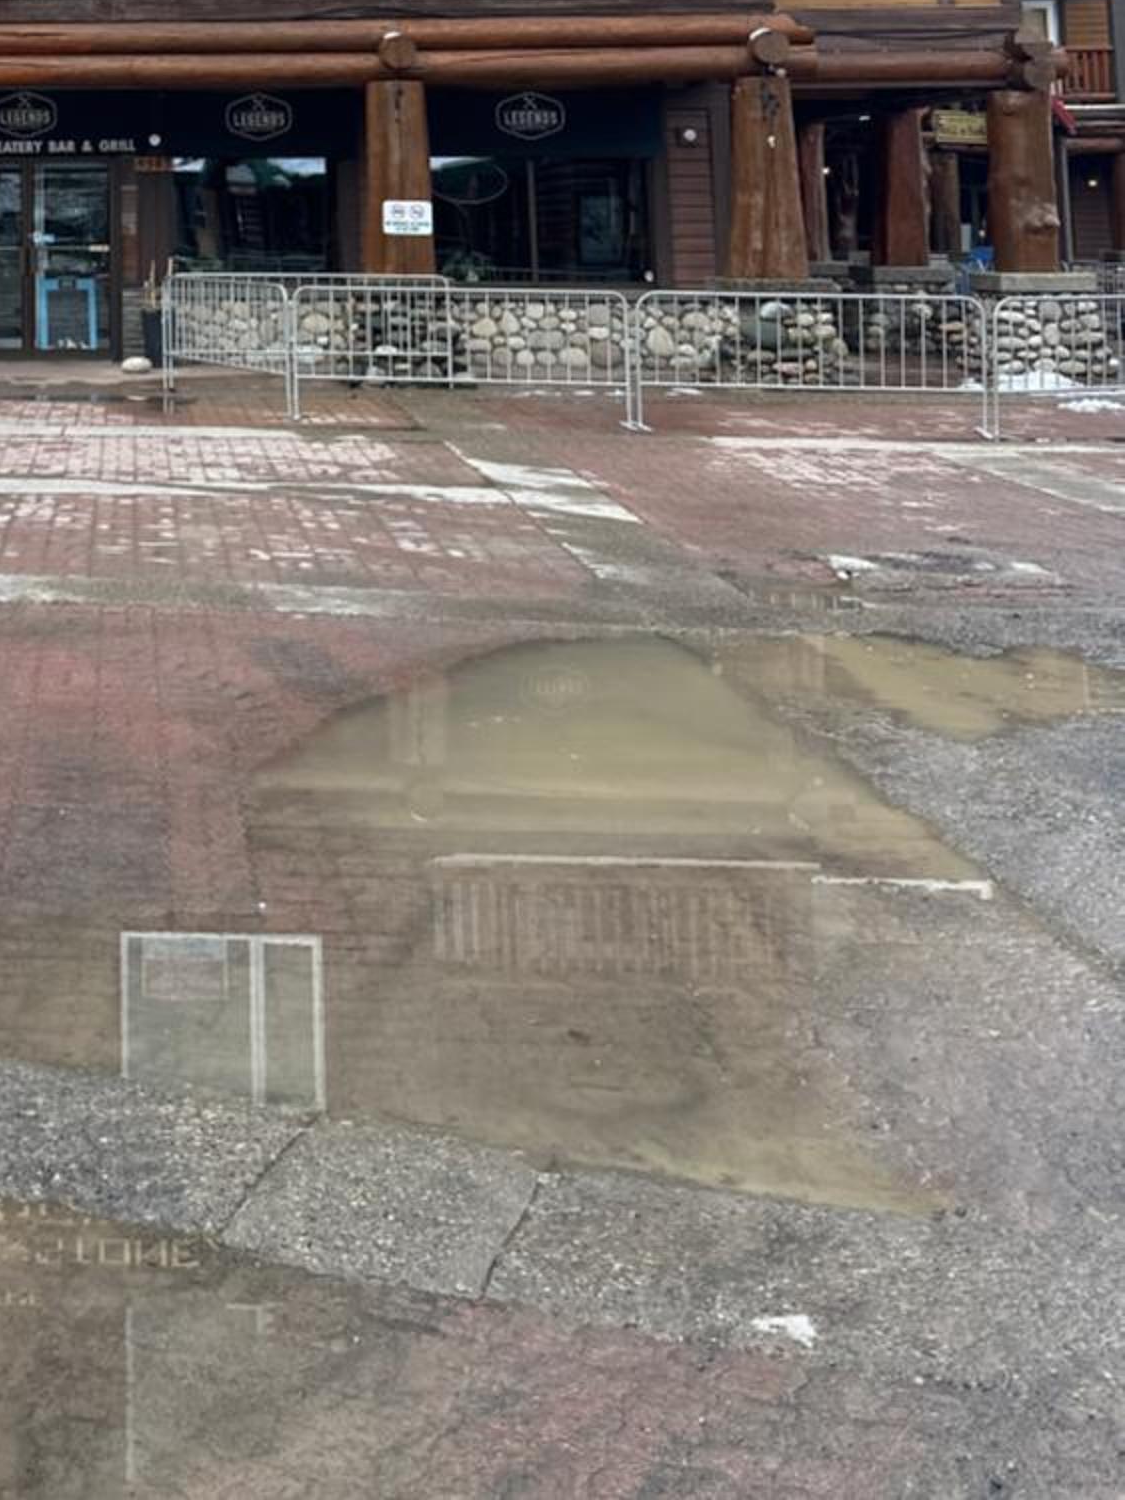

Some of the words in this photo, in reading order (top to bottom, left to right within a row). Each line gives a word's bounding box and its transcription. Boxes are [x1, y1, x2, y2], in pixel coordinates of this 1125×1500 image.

[232, 111, 286, 128] LEGENDS
[502, 110, 558, 127] LEGENDS
[47, 140, 76, 153] BAR
[81, 140, 93, 153] &
[98, 139, 136, 153] GRILL
